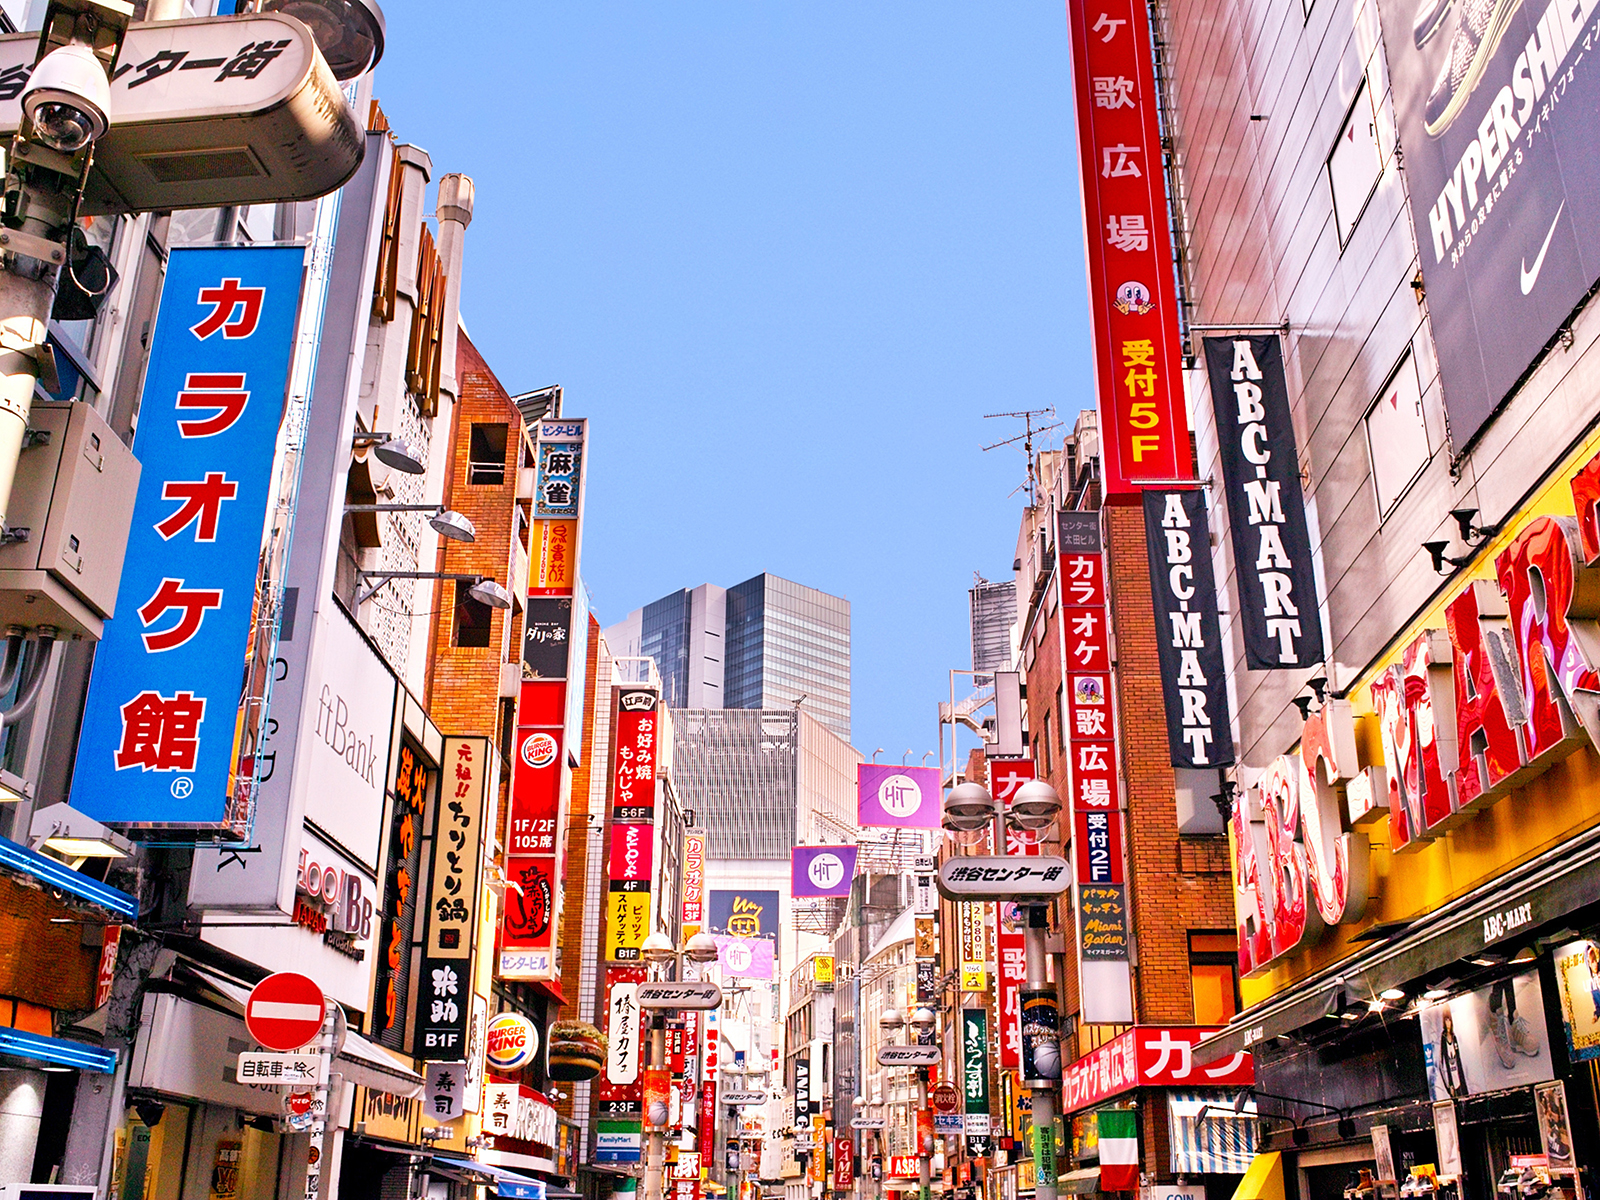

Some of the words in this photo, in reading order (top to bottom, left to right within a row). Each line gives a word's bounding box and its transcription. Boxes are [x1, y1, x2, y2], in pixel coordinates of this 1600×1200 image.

[1121, 339, 1160, 463] 受付5F
[541, 424, 583, 437] センタービル
[545, 452, 573, 505] 麻雀
[1230, 339, 1302, 664] ABC-MART
[113, 277, 267, 773] カラオケ館
[1060, 521, 1097, 531] センター街
[1063, 534, 1096, 546] 太田ビル
[1069, 555, 1101, 666] カラオケ
[525, 625, 567, 644] ダリの家
[1160, 493, 1215, 765] ABC-MART
[1231, 450, 1600, 978] ABC-MAR
[526, 740, 552, 751] BURGER
[526, 747, 554, 760] KING
[634, 717, 654, 781] お好み焼
[1075, 708, 1111, 807] 歌広場
[616, 745, 635, 803] もんじゃ
[513, 834, 553, 848] 105席
[1087, 813, 1111, 881] 受付2F
[435, 800, 471, 924] ちりとり鍋
[685, 837, 704, 902] カラオケ
[947, 866, 1065, 883] 渋谷センター街
[622, 881, 639, 892] 4F
[1082, 888, 1120, 900] パスタ
[288, 896, 328, 936] JAPAN
[683, 910, 700, 922] 3F
[684, 902, 701, 912] 受付
[1082, 902, 1122, 914] キッチン
[615, 894, 629, 946] スパゲッティ
[631, 904, 644, 941] ピッツァ
[1084, 918, 1124, 934] Miami
[1483, 901, 1533, 944] ABC-MART
[617, 948, 638, 959] B1F
[501, 957, 549, 971] センタービル
[639, 988, 716, 1001] 渋谷センター街
[424, 1032, 459, 1049] B1F
[487, 1024, 527, 1042] BURGER
[614, 992, 636, 1074] 椿屋カフェ
[486, 1034, 527, 1054] KING
[880, 1050, 938, 1061] 渋谷センター街
[1062, 1033, 1136, 1110] カラオケ歌広場
[434, 1070, 457, 1116] 寿司
[796, 1064, 809, 1113] ANAP
[934, 1093, 957, 1104] 消火栓
[492, 1091, 511, 1129] 寿司
[599, 1135, 632, 1144] FamilyMart
[969, 1136, 987, 1144] B1F
[673, 1154, 699, 1177] 豚
[838, 1140, 852, 1184] GAME
[894, 1158, 920, 1175] ASBe
